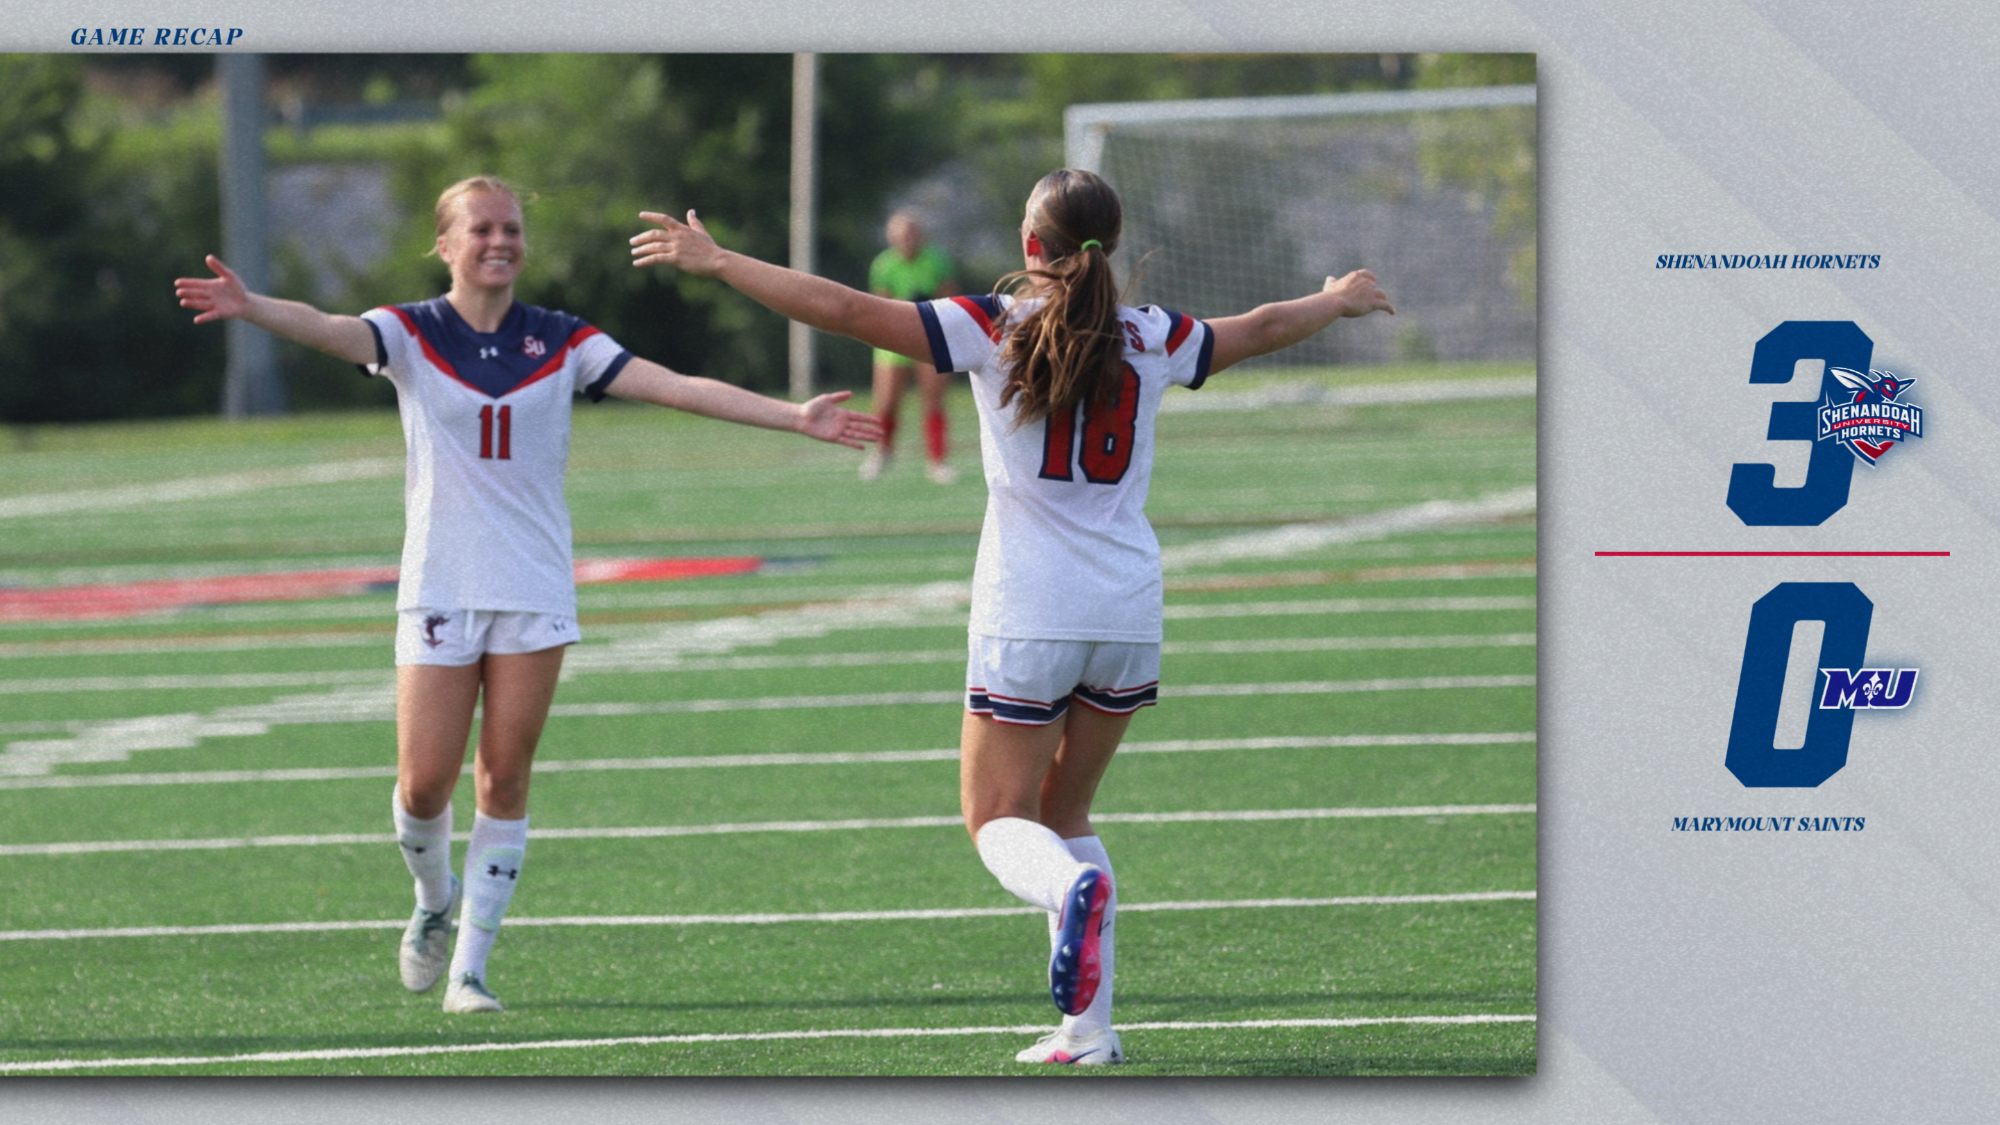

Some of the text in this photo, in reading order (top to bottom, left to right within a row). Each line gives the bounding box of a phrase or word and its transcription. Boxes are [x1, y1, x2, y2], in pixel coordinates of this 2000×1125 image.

[524, 335, 547, 356] SU
[479, 405, 511, 460] 11
[1038, 360, 1141, 485] 18
